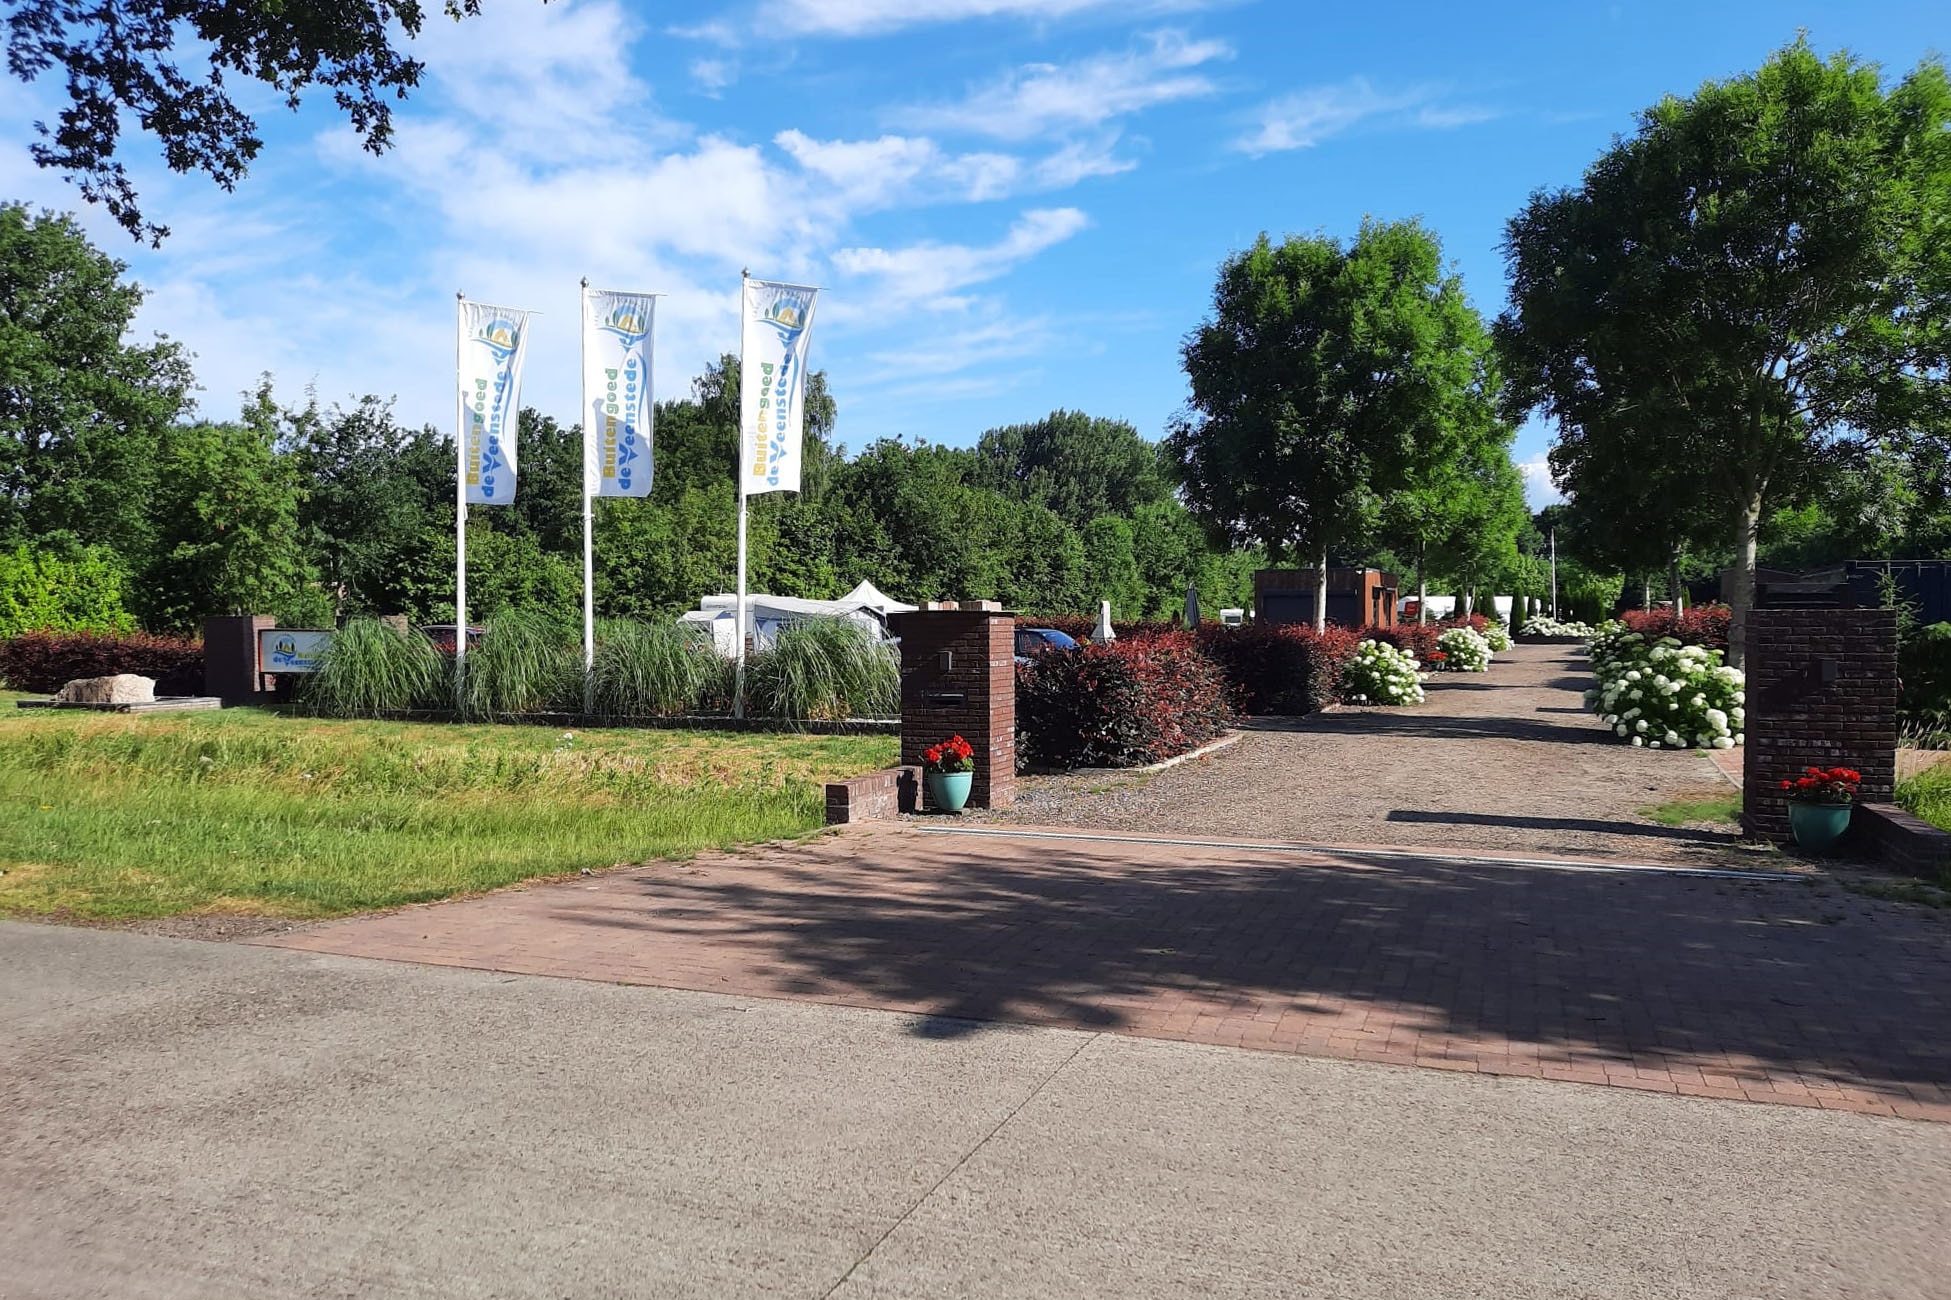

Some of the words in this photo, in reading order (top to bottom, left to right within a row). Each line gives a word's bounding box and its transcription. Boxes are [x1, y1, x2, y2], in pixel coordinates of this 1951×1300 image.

[466, 378, 487, 485] Buitengoed
[602, 368, 619, 478] Buitengoed
[618, 358, 638, 465] Veenstede
[753, 362, 774, 476] Buitengoed
[769, 354, 792, 463] Veenstede
[481, 475, 494, 497] de
[618, 467, 631, 490] de
[767, 466, 779, 486] de
